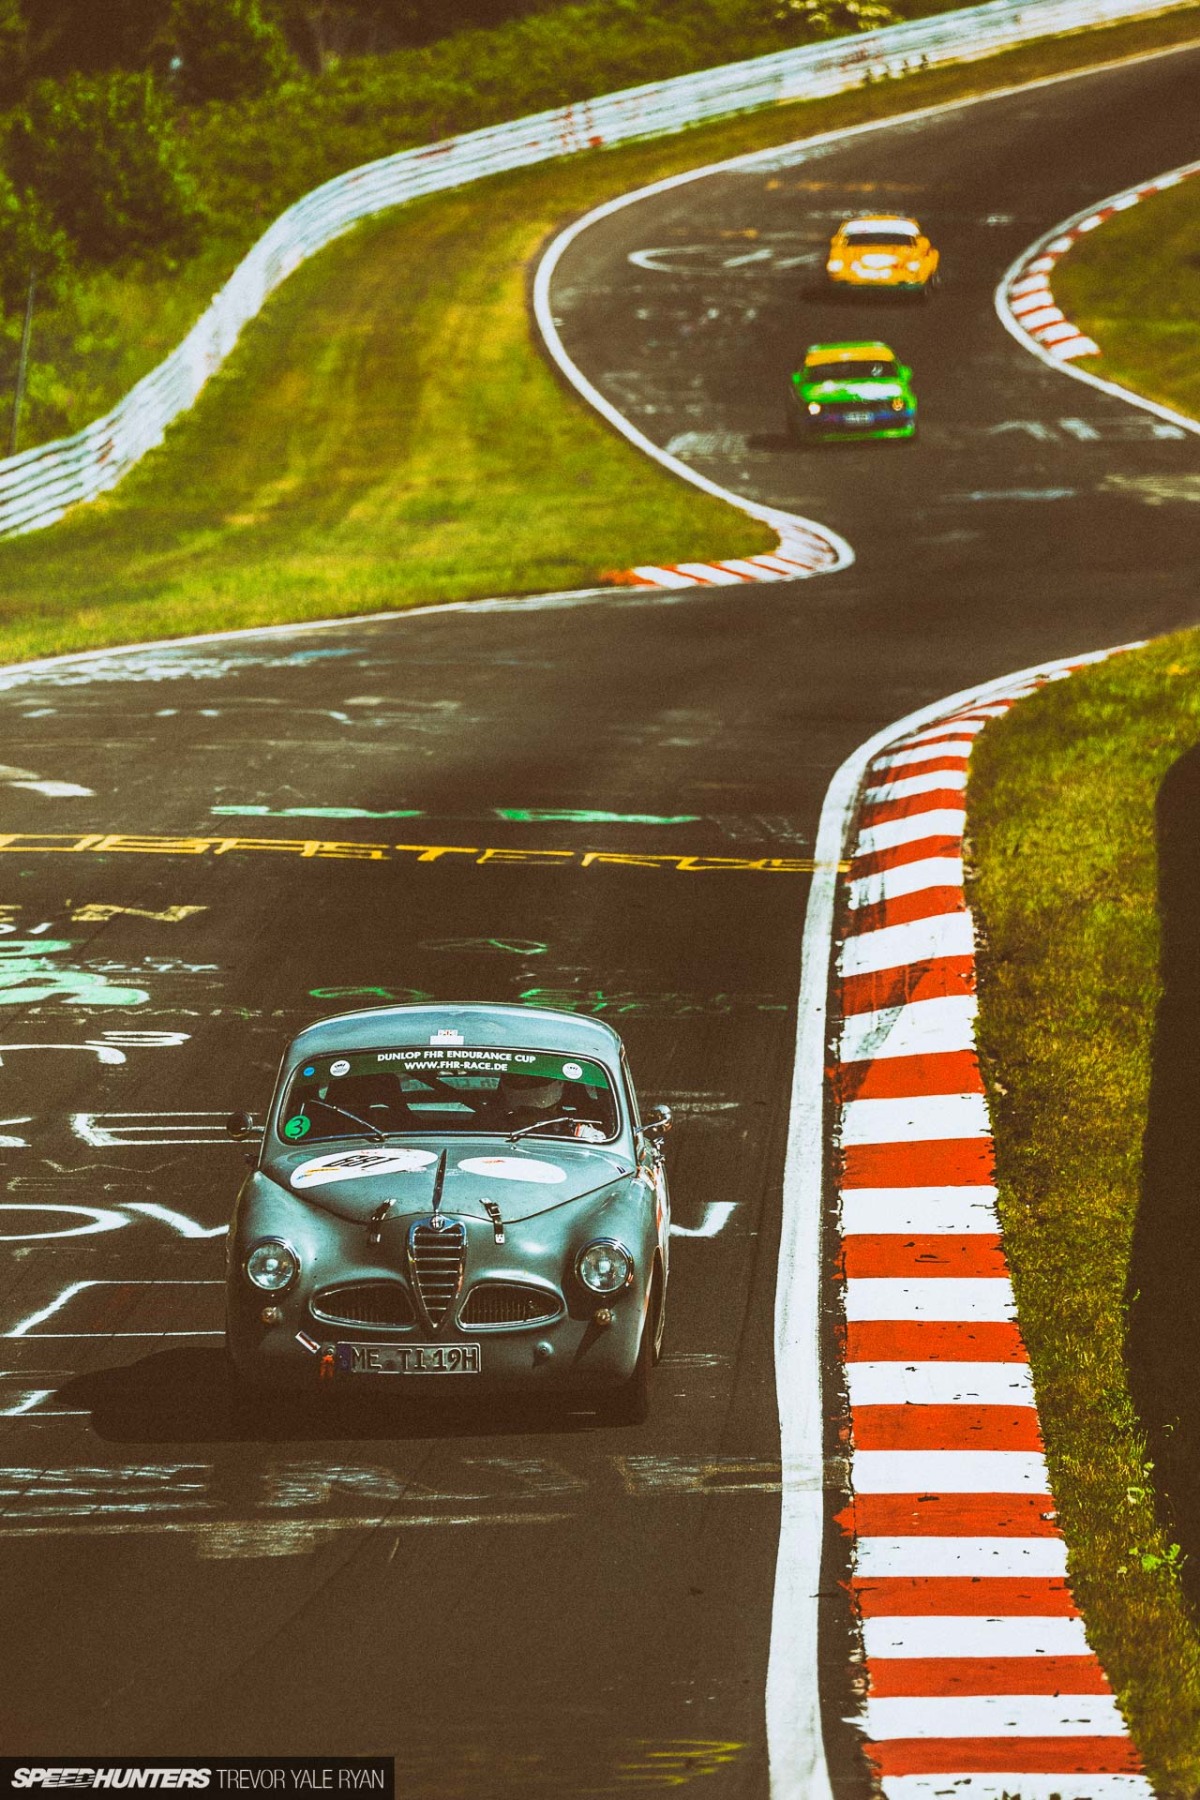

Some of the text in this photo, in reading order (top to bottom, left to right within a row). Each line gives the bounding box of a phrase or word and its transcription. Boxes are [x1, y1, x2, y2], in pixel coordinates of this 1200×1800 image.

[377, 1050, 536, 1063] DUNLOP FHR ENDURANCE CUP
[404, 1061, 508, 1072] WWW.FHR-RACE.DE
[291, 1118, 306, 1137] 3
[352, 1346, 382, 1370] ME
